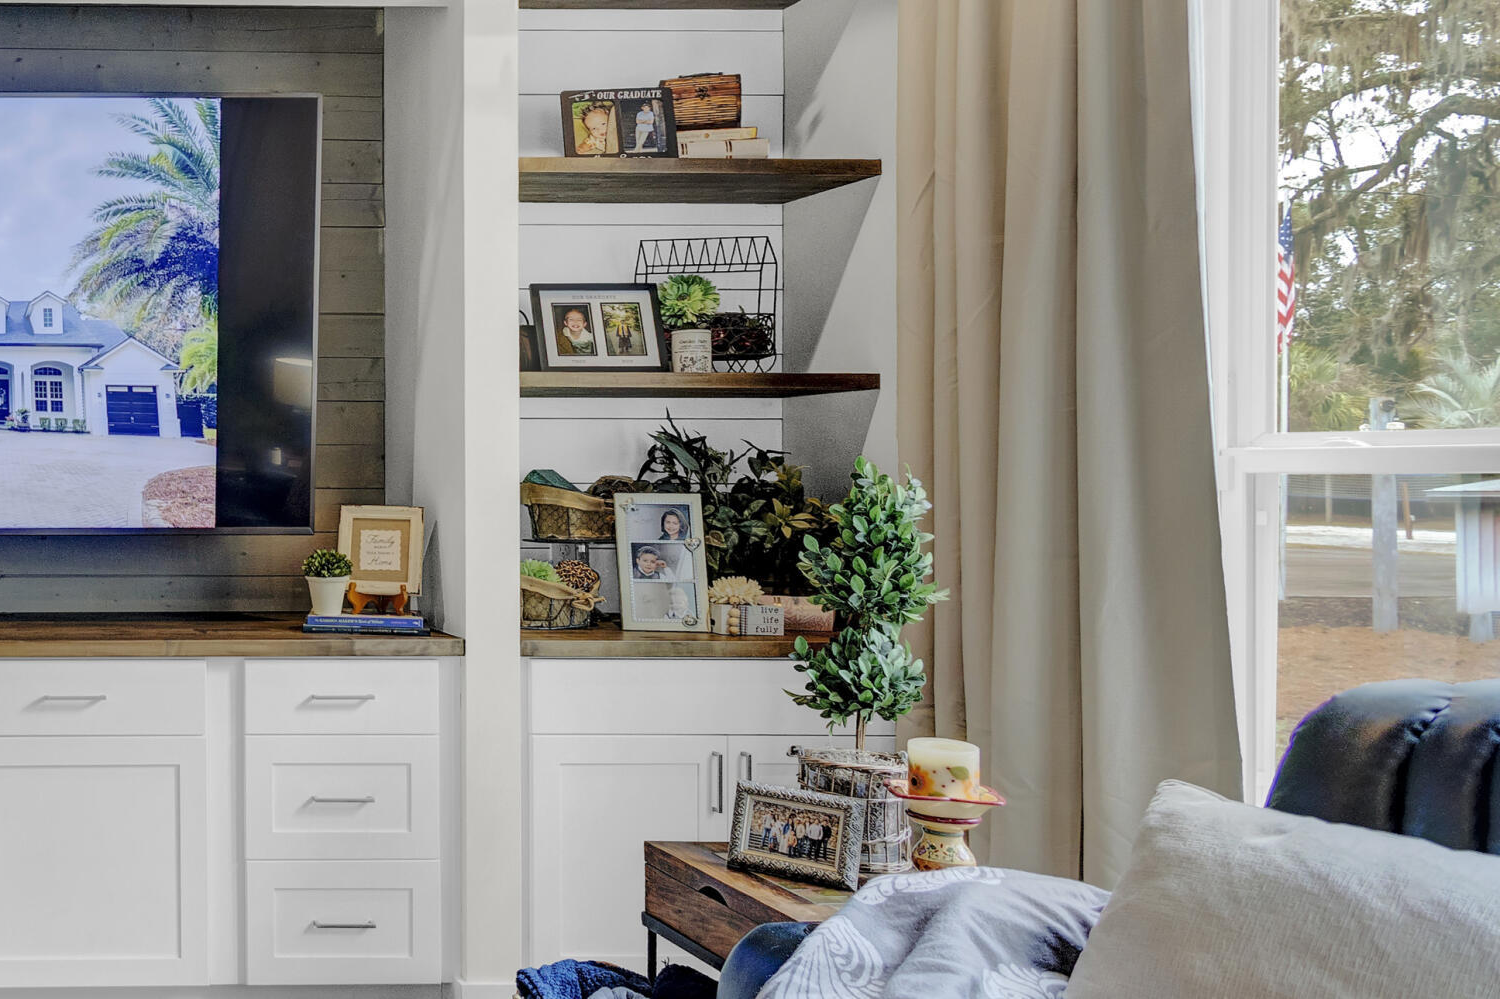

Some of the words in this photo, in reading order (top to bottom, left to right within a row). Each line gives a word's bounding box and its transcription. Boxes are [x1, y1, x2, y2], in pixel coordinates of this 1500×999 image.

[596, 91, 616, 100] OUR
[617, 89, 663, 100] GRADUATE
[763, 616, 779, 624] life
[755, 625, 779, 634] fully
